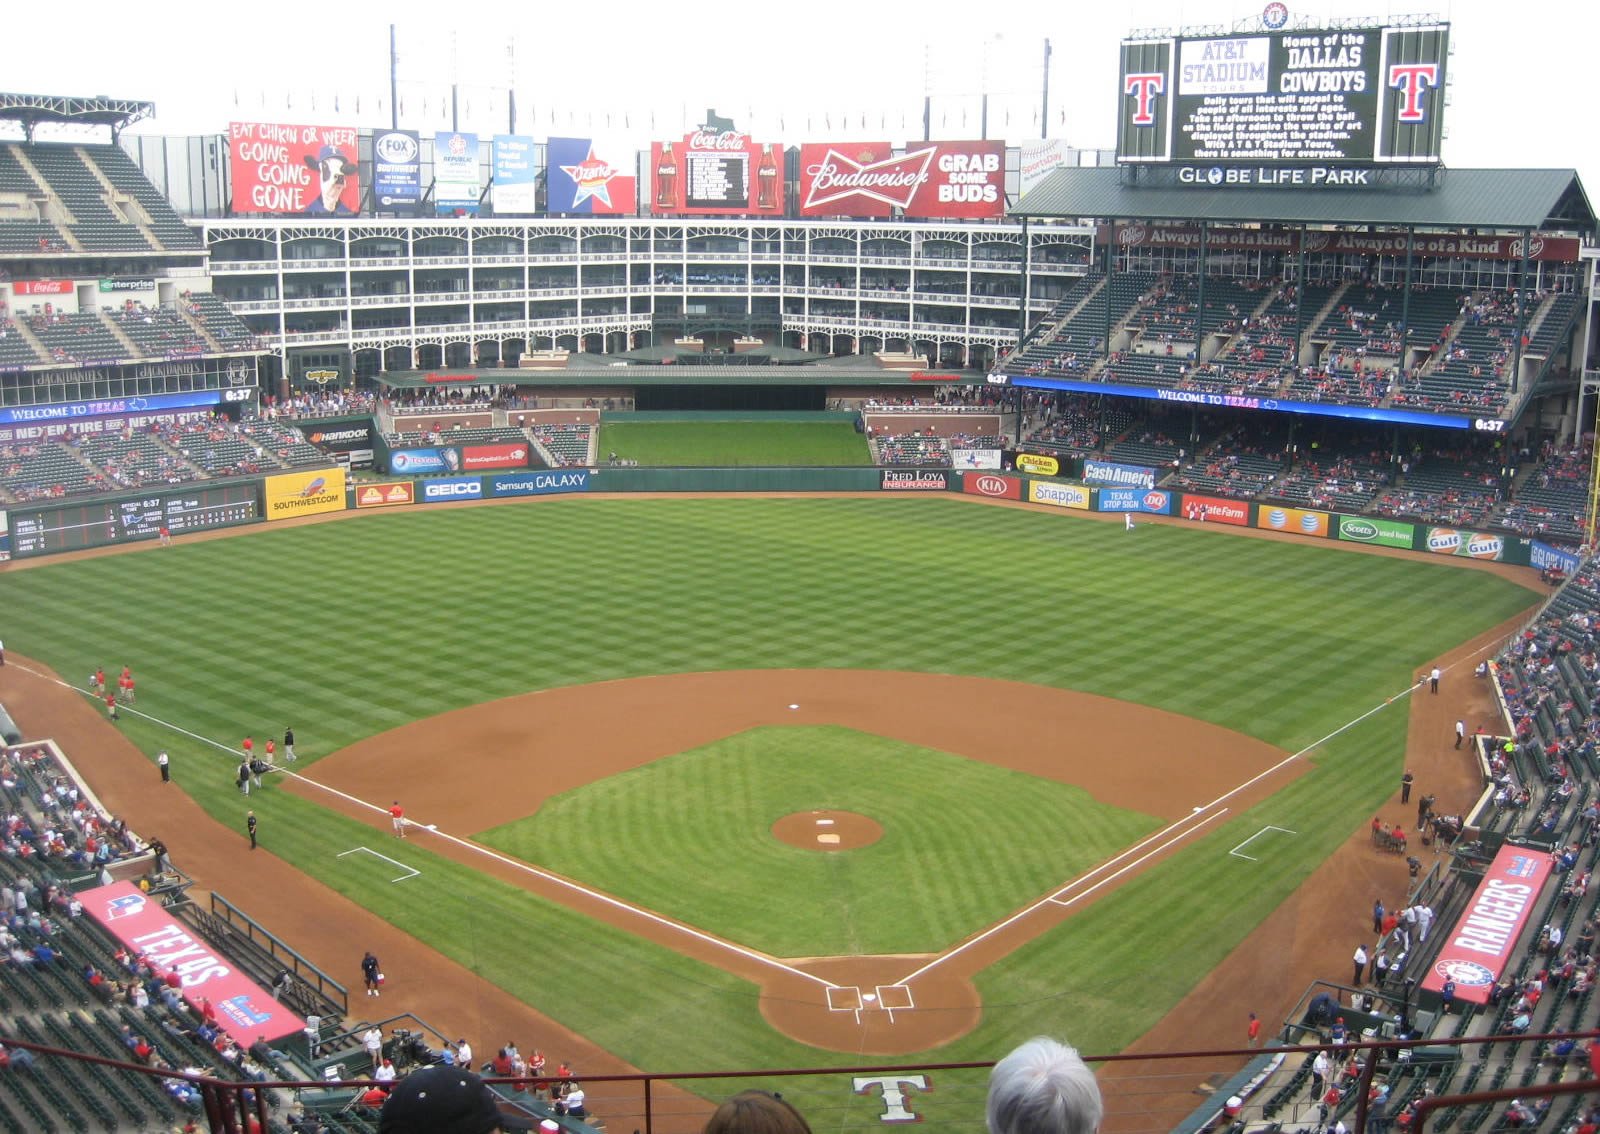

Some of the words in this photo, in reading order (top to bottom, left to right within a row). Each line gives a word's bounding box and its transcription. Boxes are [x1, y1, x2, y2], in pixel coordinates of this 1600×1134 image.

[1282, 37, 1320, 48] Home
[1323, 34, 1338, 46] of
[1341, 33, 1365, 45] the
[1202, 41, 1248, 60] AT&T
[1287, 46, 1362, 69] DALLAS
[1183, 62, 1265, 83] STADIUM
[1280, 71, 1366, 92] COWBOYS
[1204, 97, 1227, 106] Daily
[1229, 96, 1253, 105] tours
[1255, 96, 1275, 104] that
[1278, 95, 1296, 103] will
[1298, 94, 1330, 104] appeal
[1333, 94, 1344, 102] to
[1197, 106, 1227, 115] people
[1229, 105, 1239, 113] of
[1241, 105, 1253, 113] all
[1255, 104, 1298, 113] interests
[1300, 104, 1318, 112] and
[1189, 115, 1211, 123] Take
[1226, 114, 1271, 122] afternoon
[1273, 113, 1284, 121] to
[1286, 113, 1314, 121] throw
[1317, 113, 1333, 121] the
[1336, 112, 1355, 120] ball
[1182, 124, 1194, 132] on
[1196, 123, 1211, 131] the
[1213, 123, 1234, 131] field
[1236, 123, 1247, 131] or
[1248, 123, 1281, 131] admire
[1283, 122, 1299, 130] the
[1302, 121, 1331, 130] works
[1333, 121, 1344, 130] of
[1347, 122, 1361, 130] art
[232, 124, 255, 139] EAT
[259, 123, 298, 144] CHIKIN
[303, 127, 319, 145] OR
[322, 129, 356, 147] WEER
[1290, 131, 1306, 139] the
[386, 139, 409, 151] FOX
[1228, 140, 1235, 149] A
[1237, 141, 1243, 149] T
[1255, 140, 1262, 148] T
[1263, 139, 1302, 149] Stadium
[239, 142, 289, 163] GOING
[1194, 149, 1218, 158] there
[1220, 149, 1229, 158] is
[1230, 149, 1279, 159] something
[1281, 148, 1296, 158] for
[376, 163, 419, 173] SOUTHWEST
[938, 155, 999, 172] GRAB
[258, 163, 311, 185] GOING
[807, 164, 929, 190] Budweiser
[949, 172, 988, 184] SOME
[1258, 167, 1304, 184] LIFE
[1311, 167, 1368, 184] PARK
[252, 184, 306, 210] GONE
[938, 184, 998, 203] BUDS
[1151, 230, 1200, 245] Always
[1231, 231, 1246, 244] of
[1257, 231, 1292, 246] Kind
[1336, 235, 1392, 250] Always
[1427, 238, 1448, 251] of
[1458, 238, 1499, 253] Kind
[987, 374, 1008, 384] 6:37
[225, 389, 252, 401] 6:37
[1157, 389, 1205, 404] WELCOME
[1208, 394, 1222, 405] TO
[1224, 395, 1259, 408] TEXAS
[11, 406, 69, 420] WELCOME
[70, 405, 87, 415] TO
[89, 401, 125, 413] TEXAS
[70, 420, 103, 434] TIRE
[1475, 418, 1504, 432] 6:37
[1022, 456, 1053, 468] Chicken
[884, 471, 912, 482] FRED
[916, 471, 945, 482] LOYA
[1085, 463, 1113, 482] Cash
[495, 481, 534, 492] Samsung
[536, 474, 586, 489] GALAXY
[883, 481, 946, 489] INSURANCE
[981, 479, 1002, 493] KIA
[425, 482, 481, 497] GEICO
[1035, 483, 1084, 506] Snapple
[1110, 491, 1133, 501] TEXAS
[143, 499, 160, 508] 6:37
[273, 494, 339, 511] SOUTHWEST.COM
[1103, 499, 1121, 509] STOP
[1121, 500, 1140, 509] SIGN
[1147, 494, 1163, 506] DQ
[1346, 523, 1373, 536] Scotts
[1379, 530, 1396, 538] used
[1429, 535, 1459, 548] Gulf
[1469, 541, 1501, 554] Gulf
[1454, 879, 1533, 956] RANGERS
[132, 923, 231, 989] TEXAS
[851, 1073, 932, 1124] T
